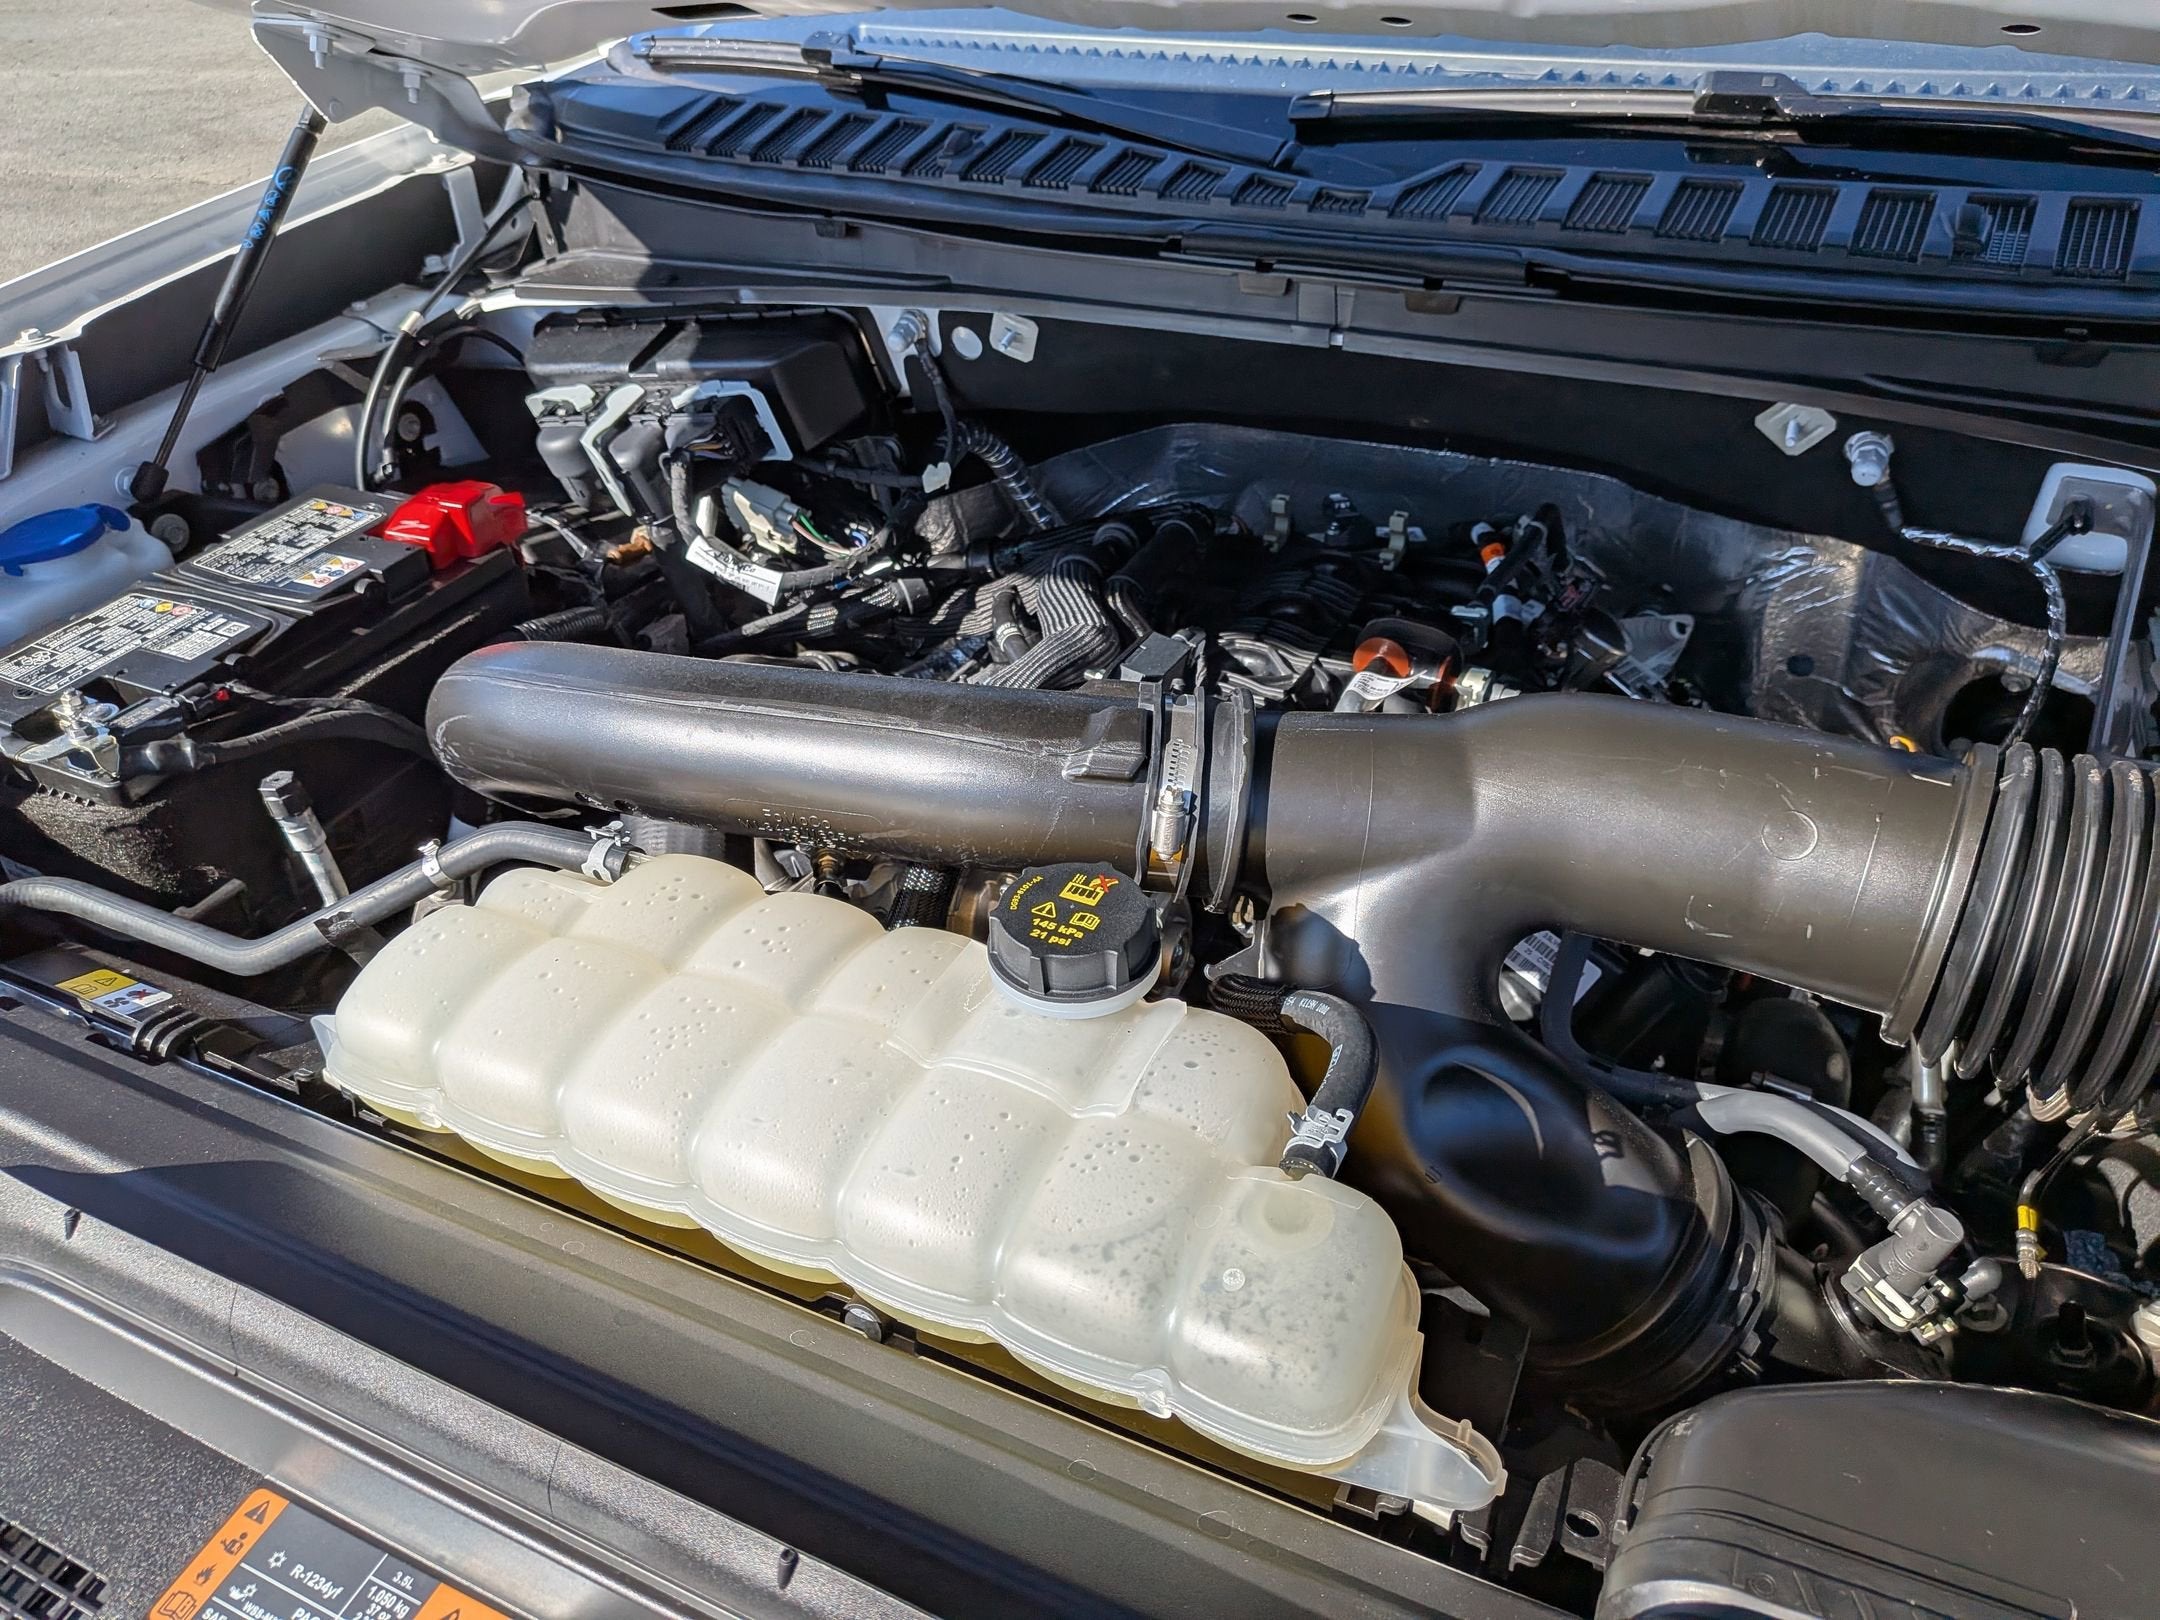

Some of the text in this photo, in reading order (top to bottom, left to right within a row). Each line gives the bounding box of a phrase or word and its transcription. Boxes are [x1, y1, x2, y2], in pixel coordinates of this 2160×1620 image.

[1029, 929, 1072, 946] 21 psi
[1032, 918, 1084, 939] 145 kPa
[289, 1563, 345, 1600] R-1234yf
[392, 1571, 415, 1591] 3.5L
[366, 1602, 382, 1616] 37
[367, 1585, 398, 1609] 1.050
[393, 1600, 411, 1619] kg
